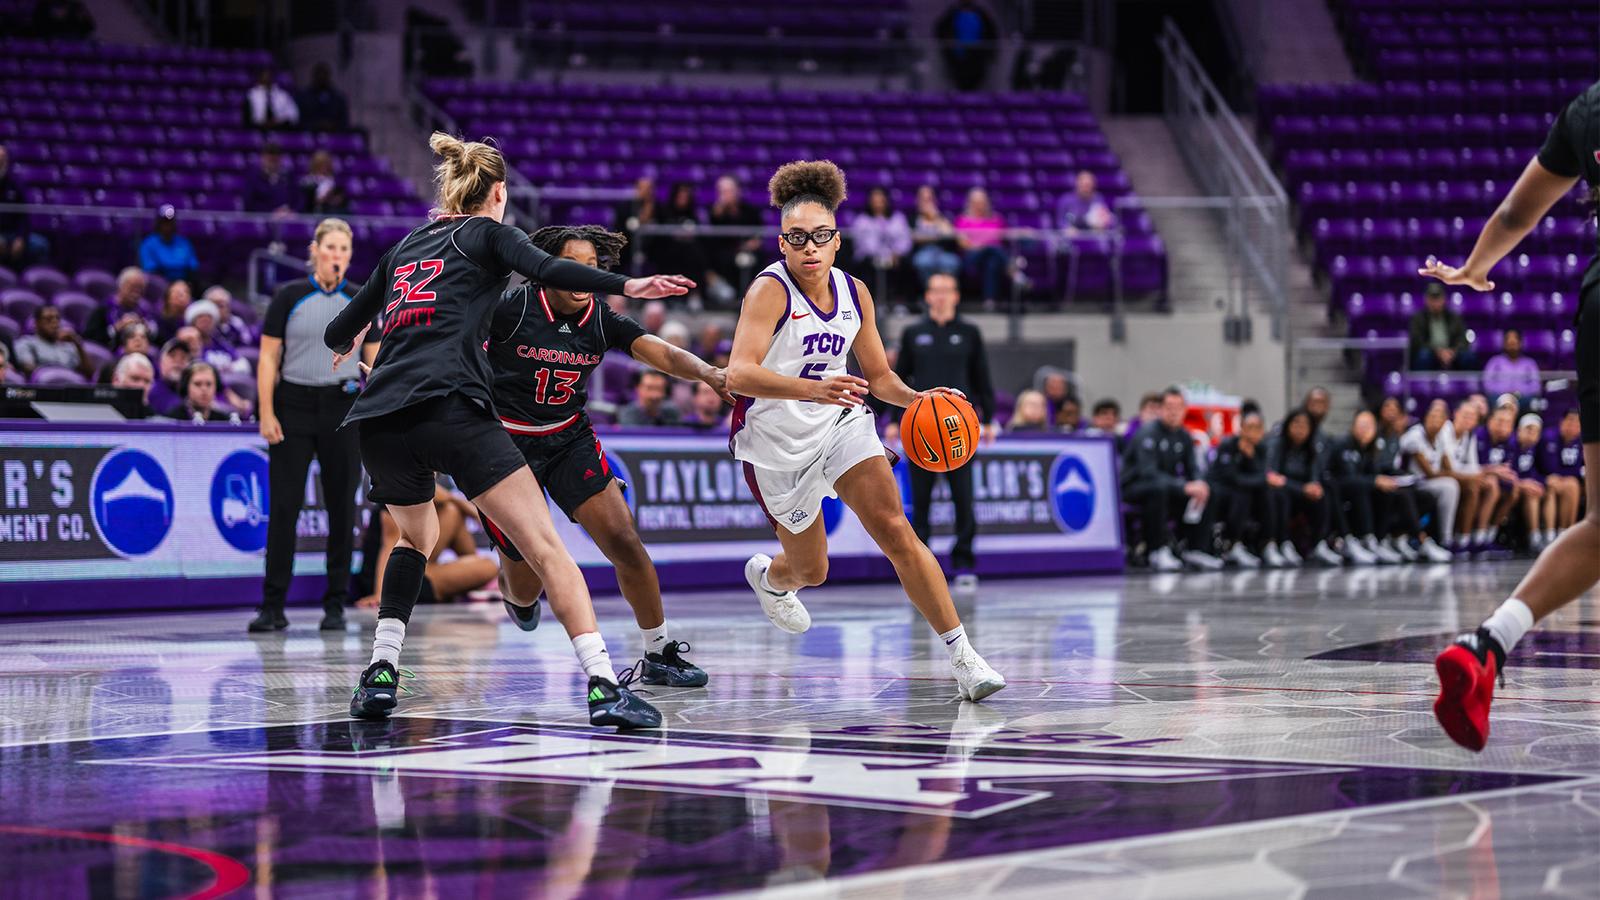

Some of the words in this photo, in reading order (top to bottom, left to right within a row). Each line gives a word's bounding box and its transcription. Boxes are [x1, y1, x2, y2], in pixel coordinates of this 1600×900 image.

[386, 259, 444, 314] 32
[516, 344, 601, 366] CARDINALS
[802, 332, 846, 357] TCU
[534, 367, 581, 405] 13
[943, 415, 967, 460] ELITE
[4, 459, 74, 509] R'S
[57, 513, 90, 541] CO.
